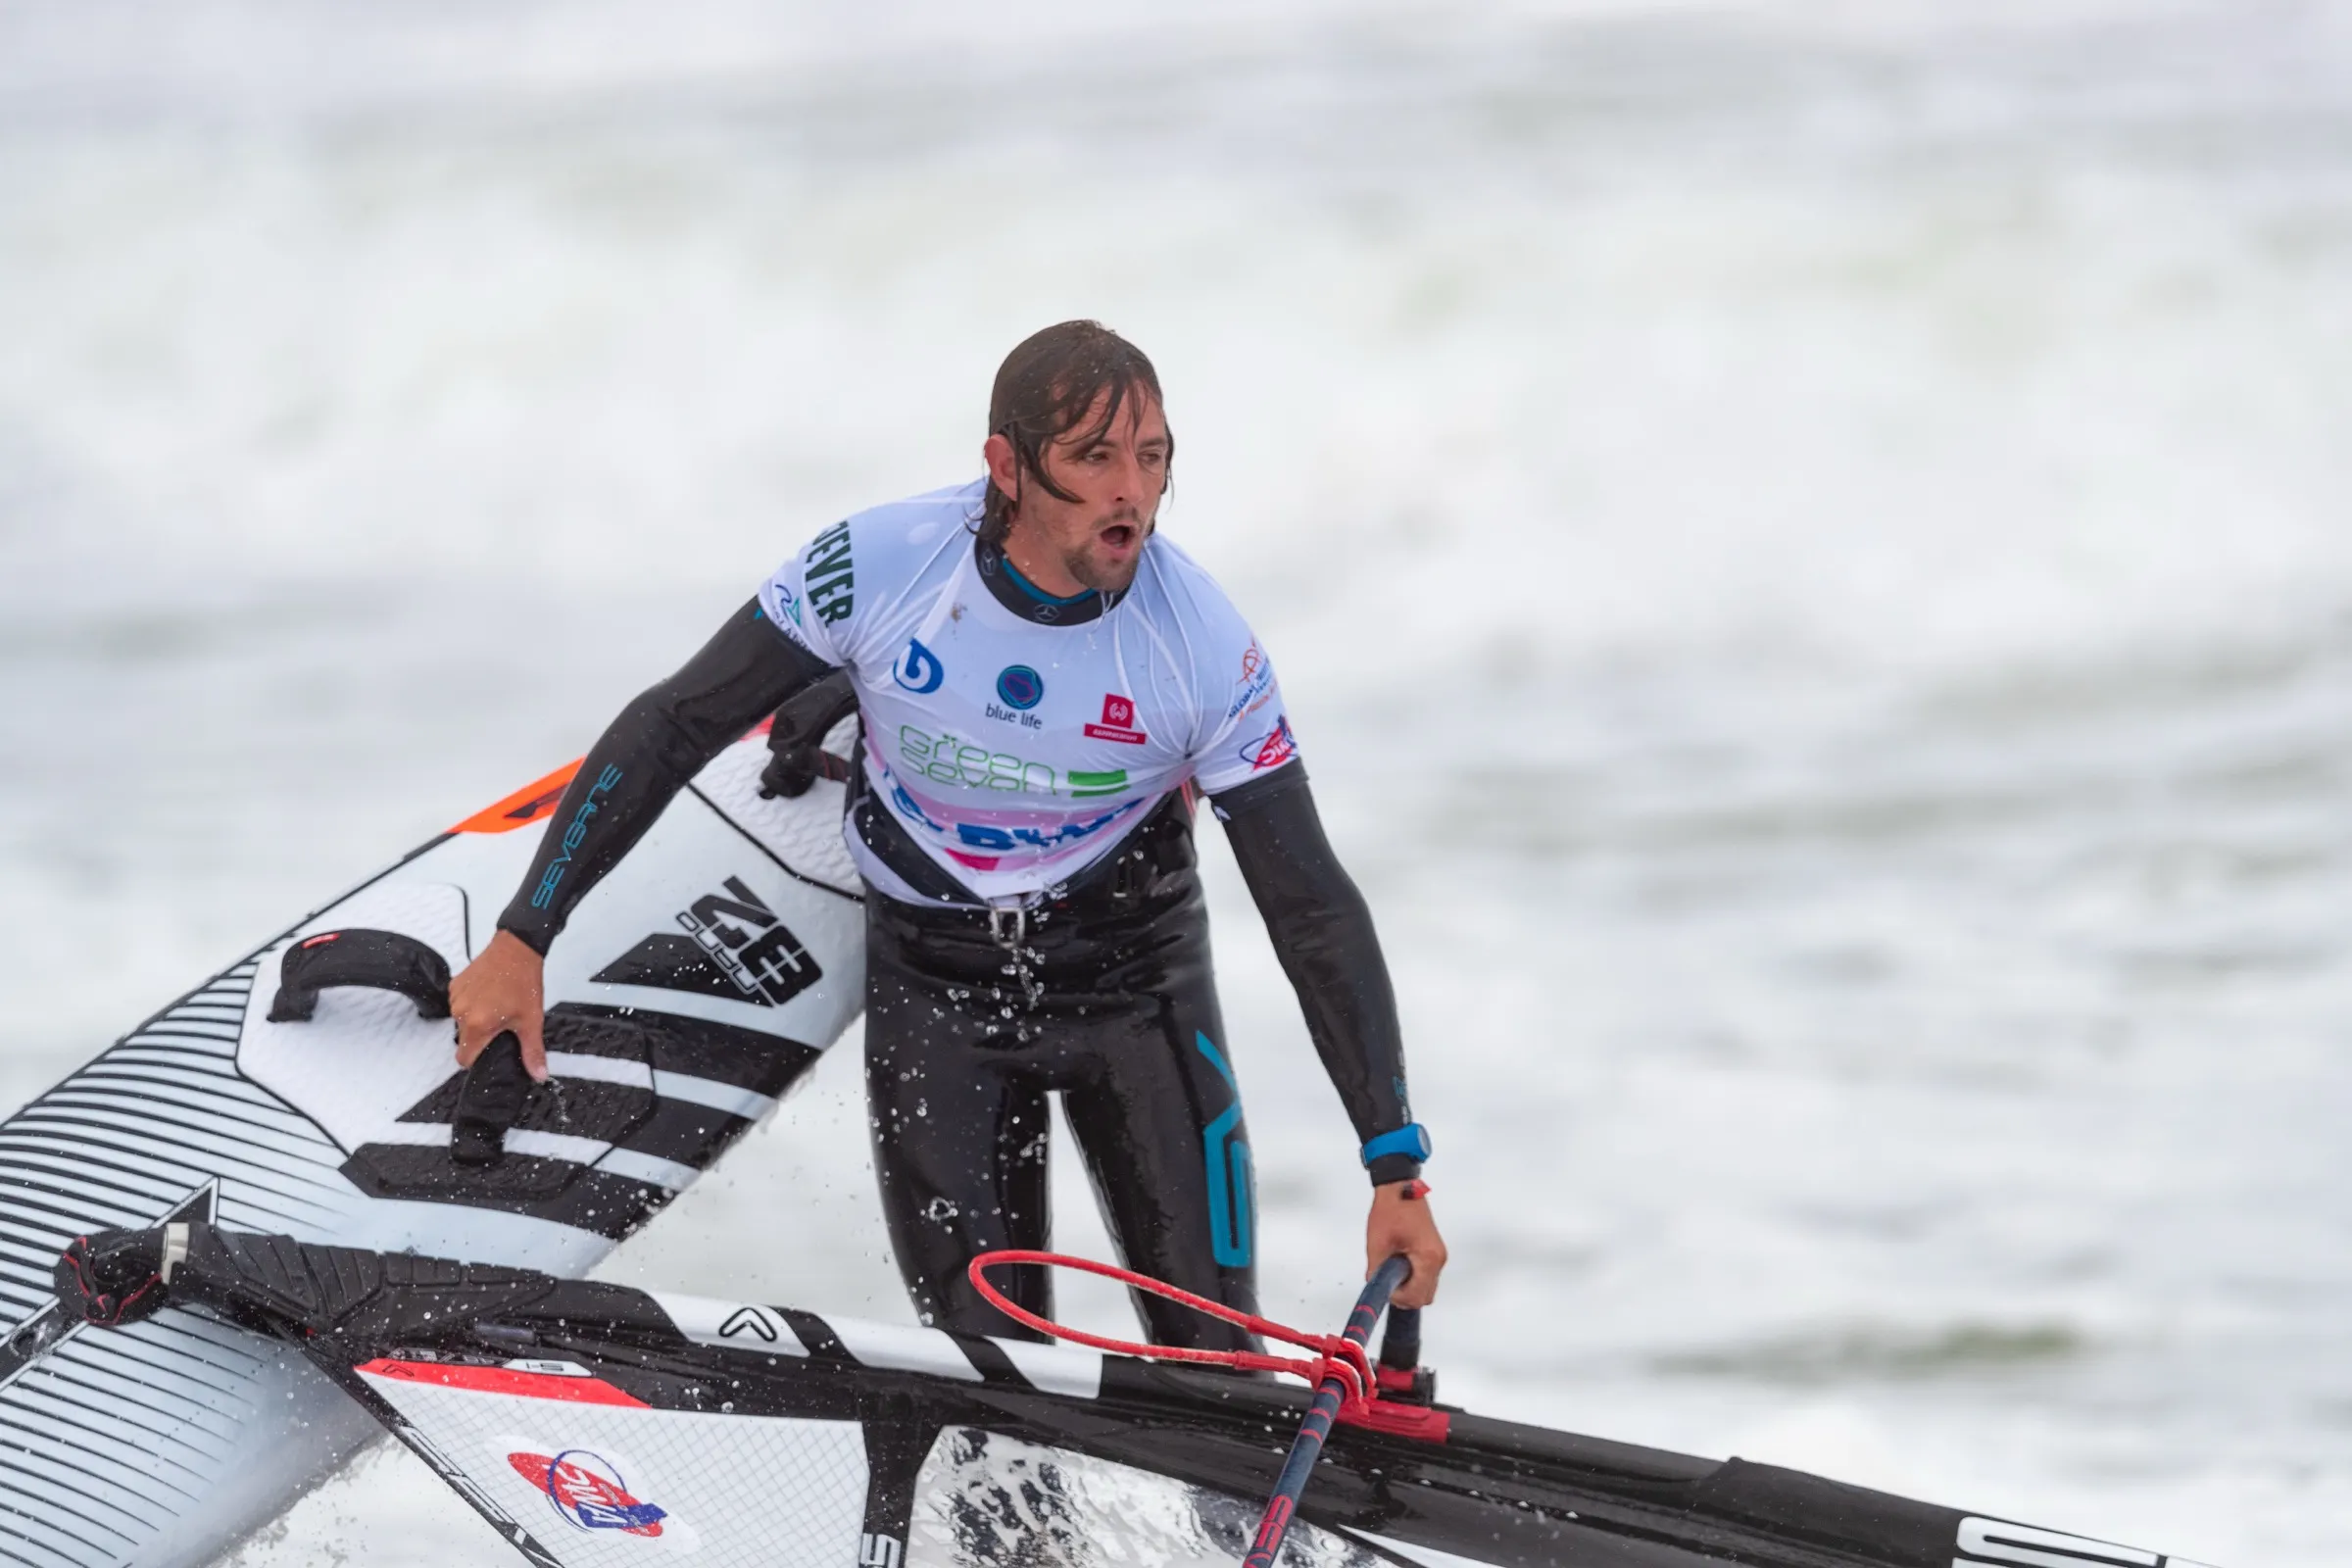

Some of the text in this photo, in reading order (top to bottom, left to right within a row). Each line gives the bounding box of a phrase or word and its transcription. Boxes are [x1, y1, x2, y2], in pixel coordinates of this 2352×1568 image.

[984, 703, 1043, 730] blue life
[531, 762, 623, 909] SEVERNE
